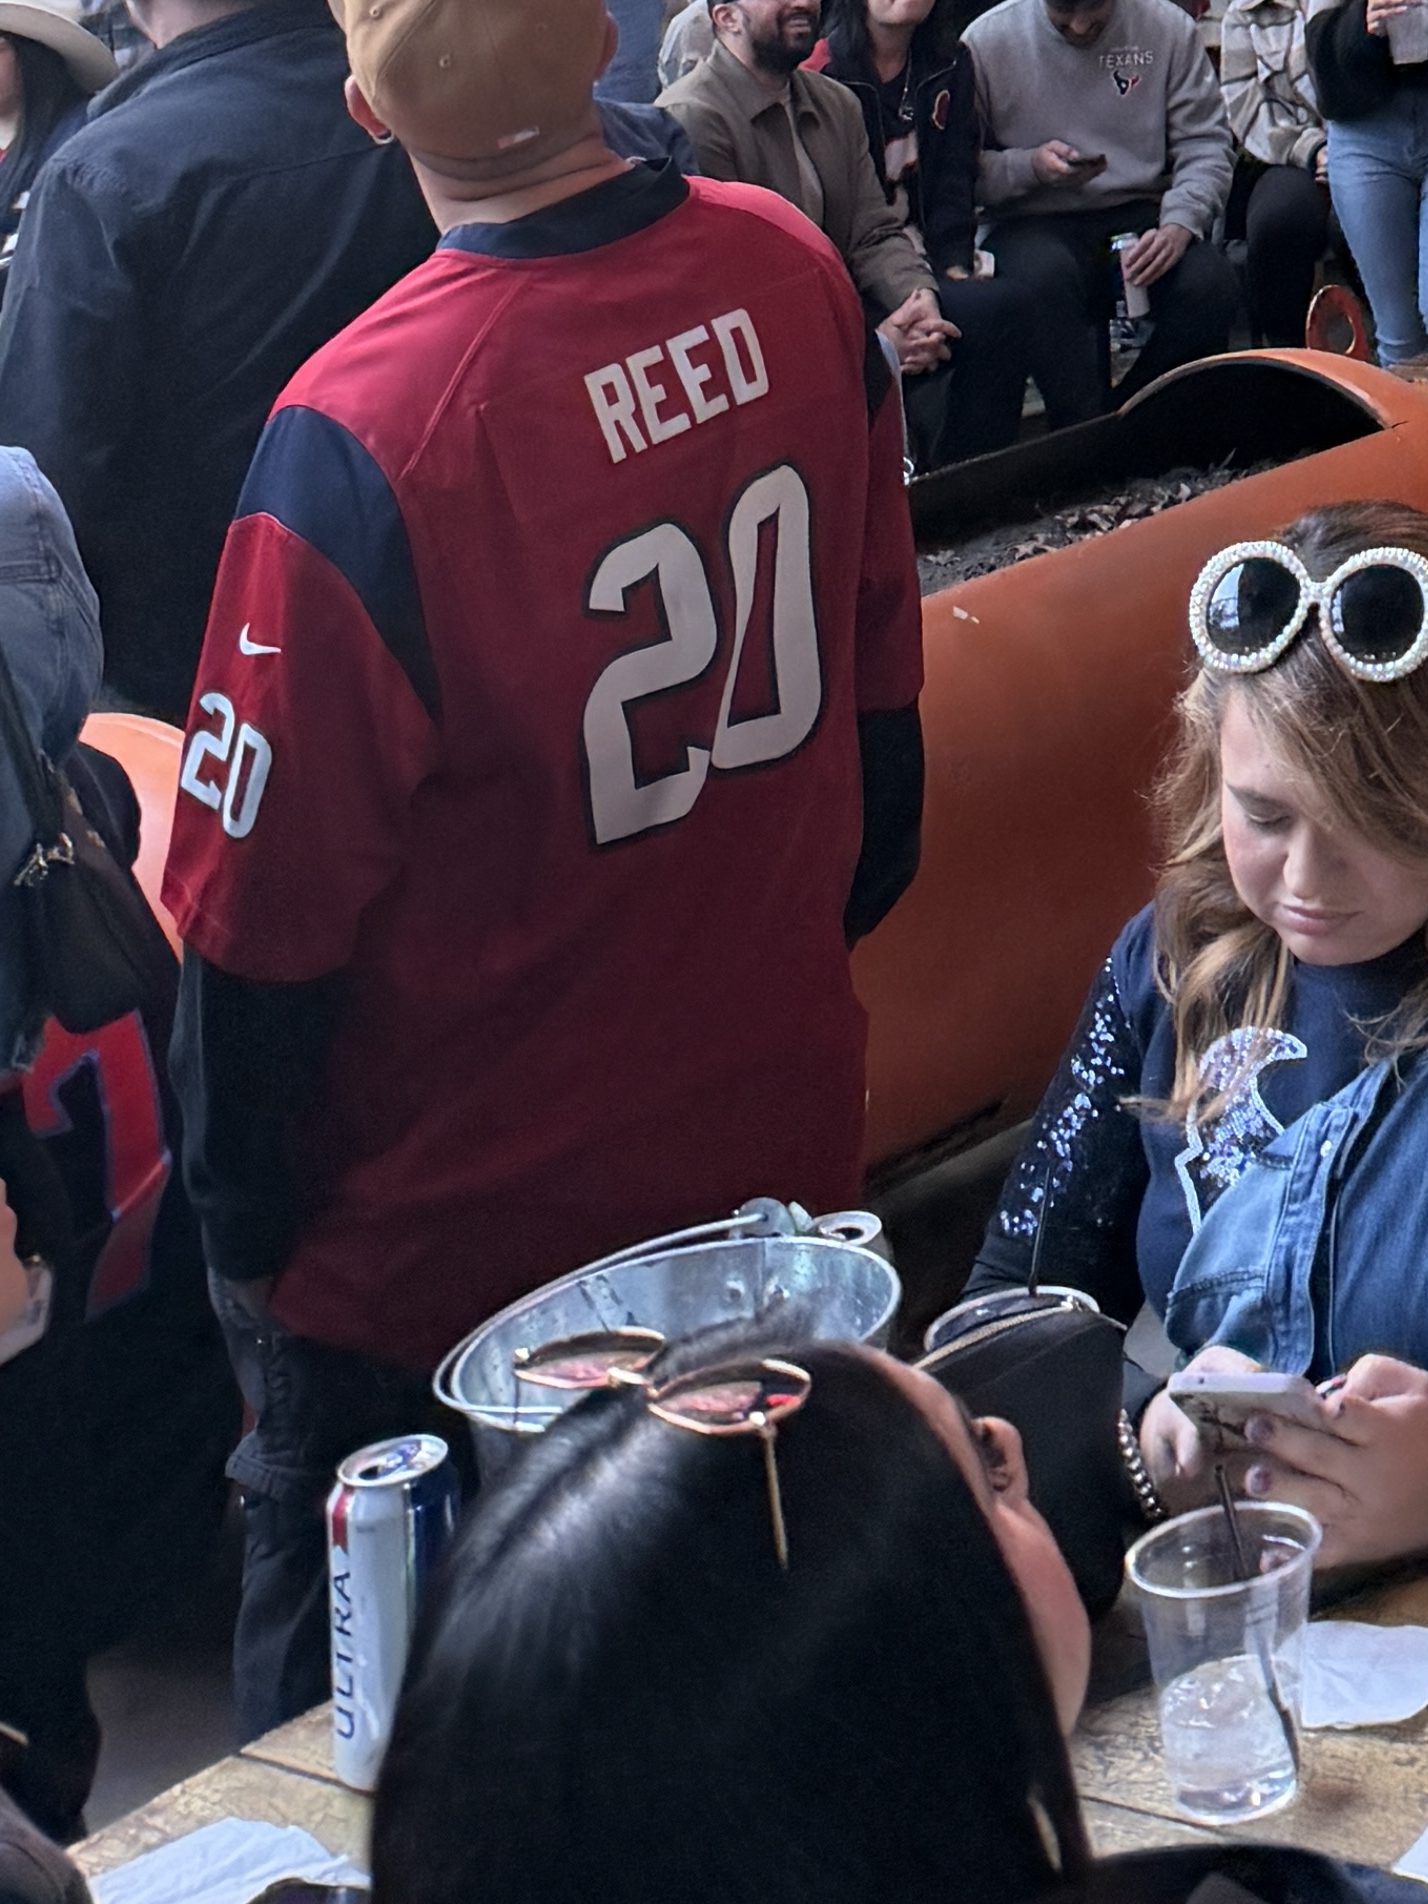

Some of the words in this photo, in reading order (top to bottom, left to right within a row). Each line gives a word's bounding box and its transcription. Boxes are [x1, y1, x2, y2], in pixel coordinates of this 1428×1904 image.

[1099, 50, 1154, 69] TEXANS
[584, 306, 770, 465] REED
[579, 462, 828, 848] 20
[179, 691, 274, 840] 20
[332, 1570, 356, 1740] ULTRA
